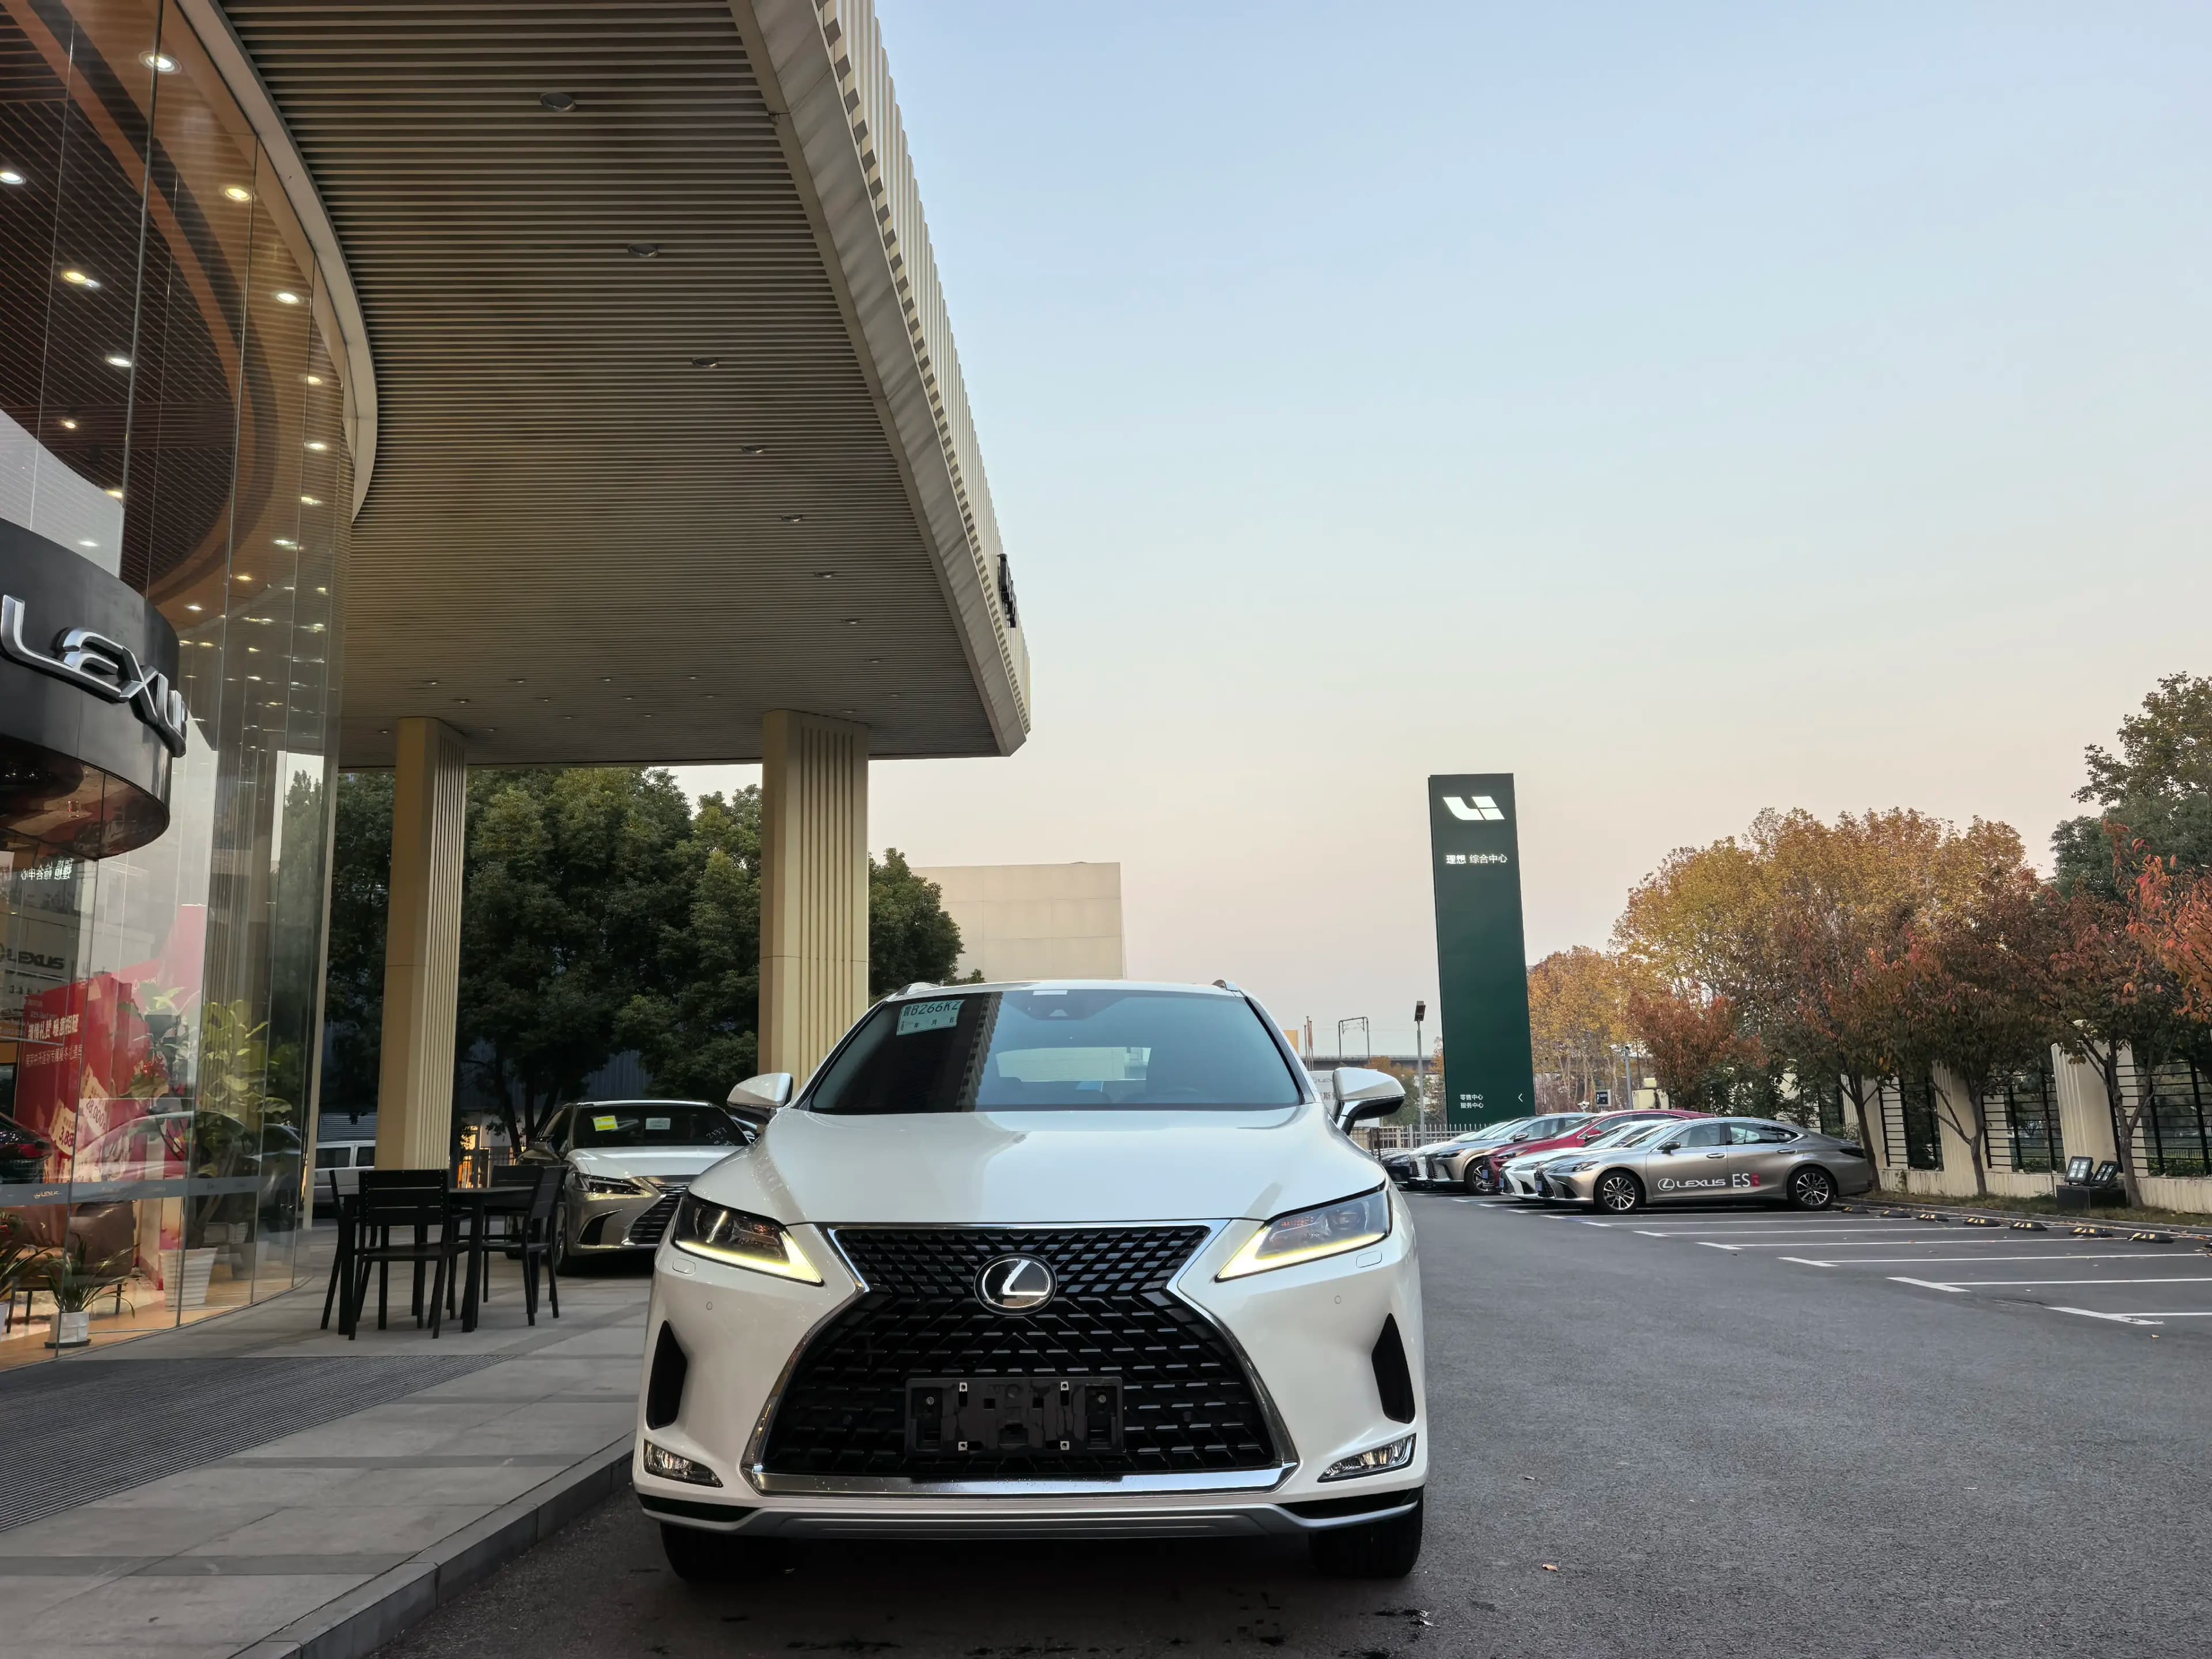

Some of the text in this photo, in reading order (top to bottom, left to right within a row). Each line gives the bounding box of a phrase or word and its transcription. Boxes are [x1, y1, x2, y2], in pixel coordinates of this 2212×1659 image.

[1, 594, 188, 757] LEXU
[1446, 854, 1508, 864] 理想 综合中心
[1677, 1179, 1725, 1188] LEXUS
[1732, 1173, 1751, 1188] ES
